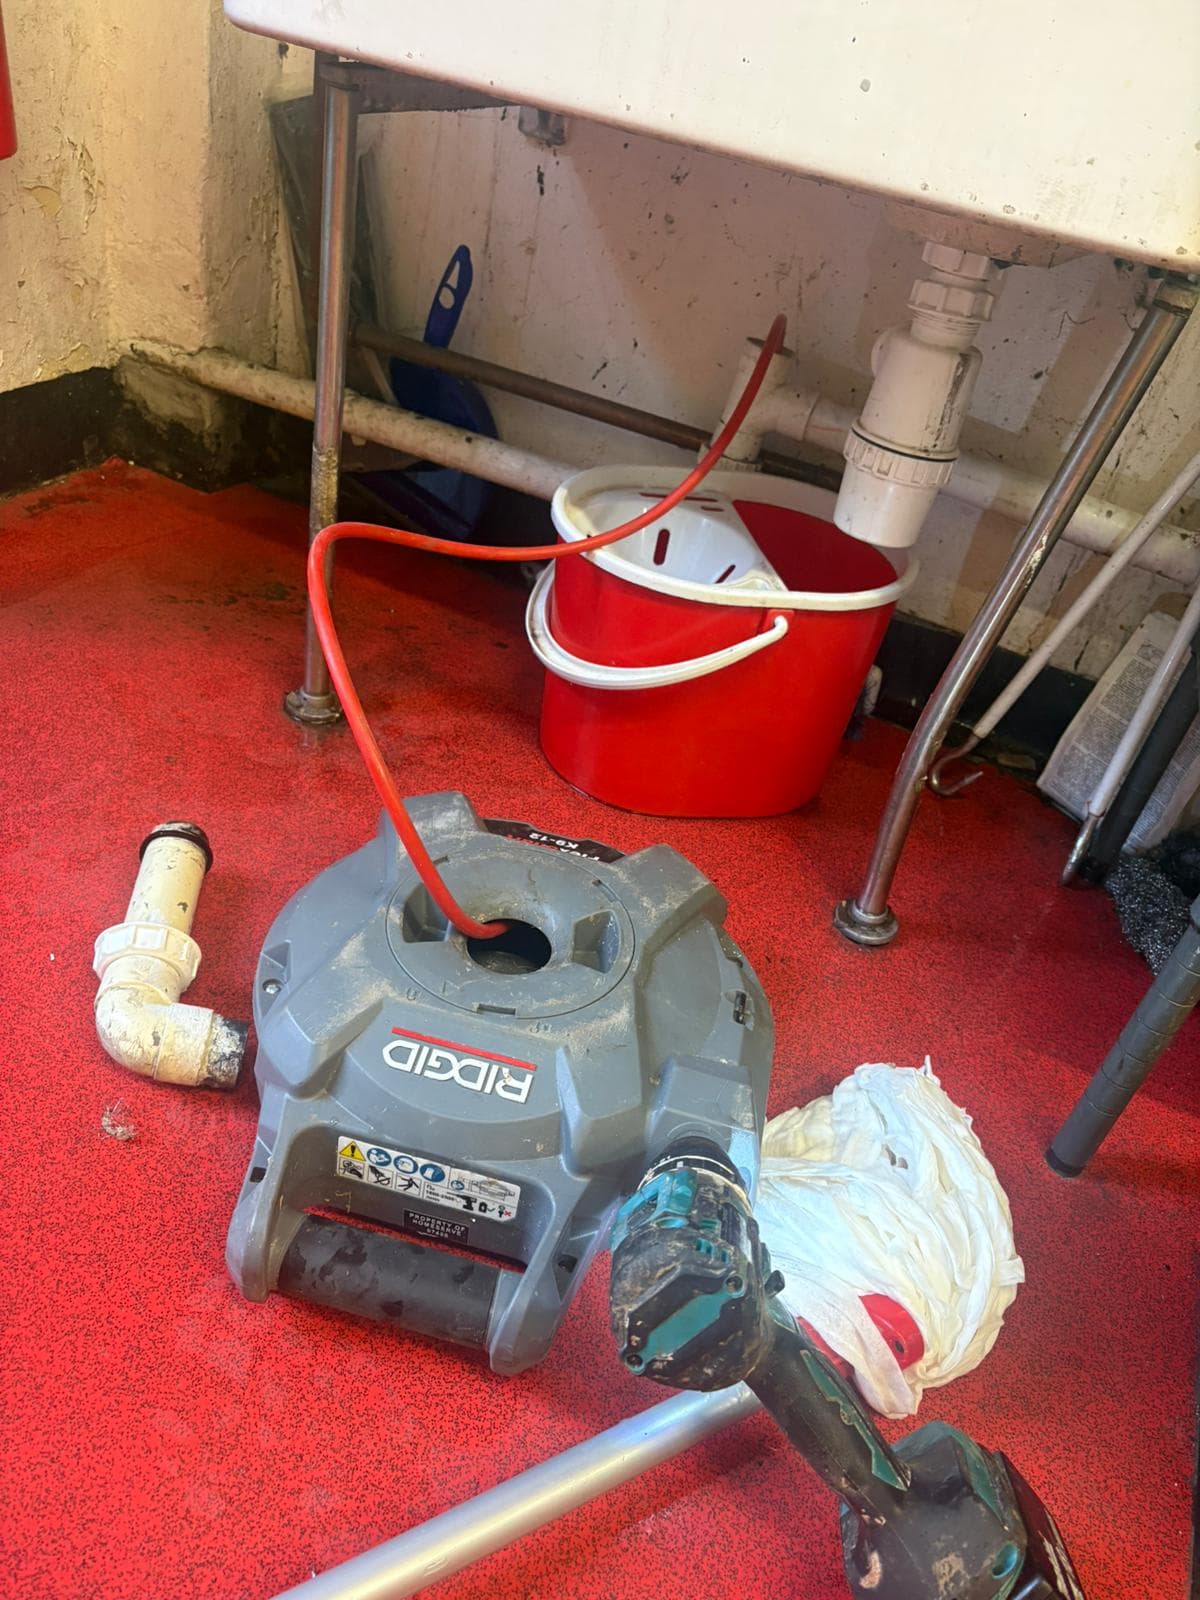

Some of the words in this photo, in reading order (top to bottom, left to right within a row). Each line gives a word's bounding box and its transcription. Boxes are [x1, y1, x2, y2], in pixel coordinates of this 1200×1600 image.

[382, 1039, 534, 1104] RIDGID
[409, 1212, 452, 1227] PROPERTY
[454, 1224, 466, 1232] OF
[412, 1218, 461, 1236] HOMESERVE
